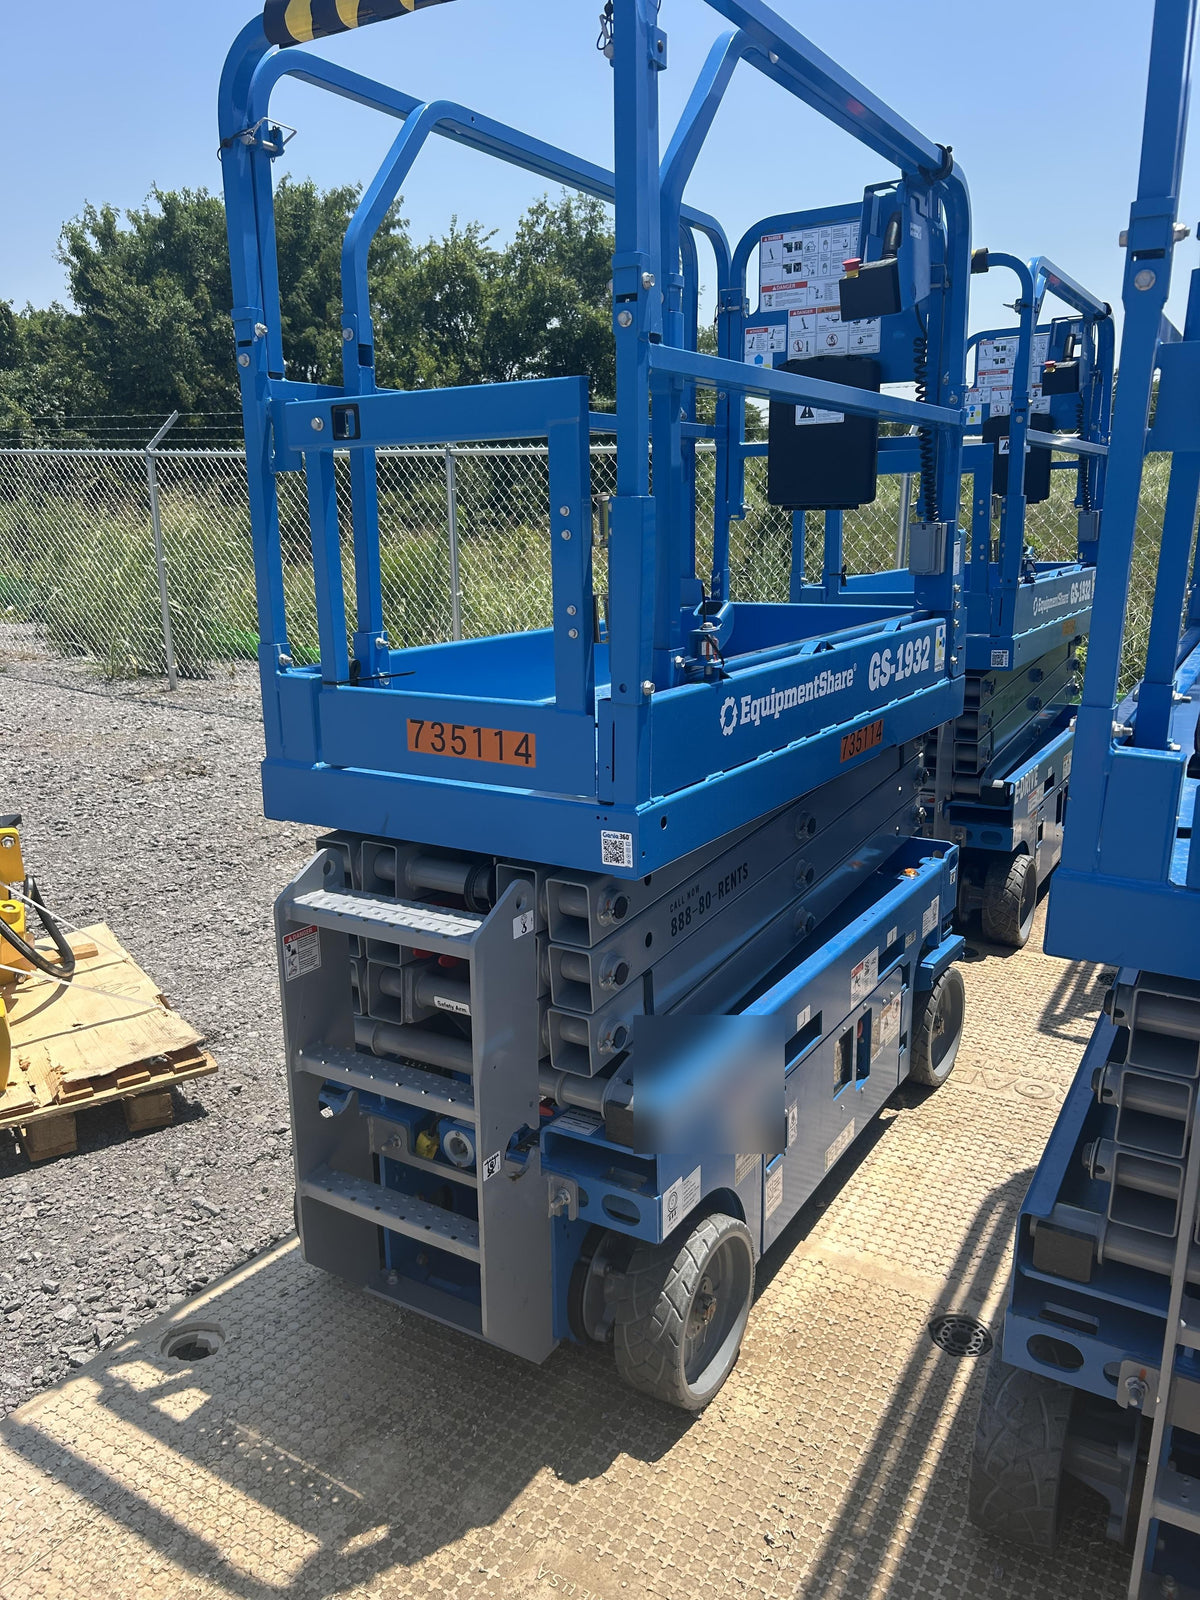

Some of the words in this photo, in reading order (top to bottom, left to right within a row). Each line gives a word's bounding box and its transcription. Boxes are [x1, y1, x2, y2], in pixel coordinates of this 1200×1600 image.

[868, 635, 931, 691] GS-1932
[410, 719, 532, 764] 735114
[842, 721, 883, 761] 735114
[670, 896, 685, 913] CALL
[687, 884, 700, 899] NOW
[671, 862, 749, 937] 888-80-RENTS
[293, 927, 313, 941] DANGER
[437, 1000, 455, 1011] Safety
[455, 1005, 467, 1013] Arm
